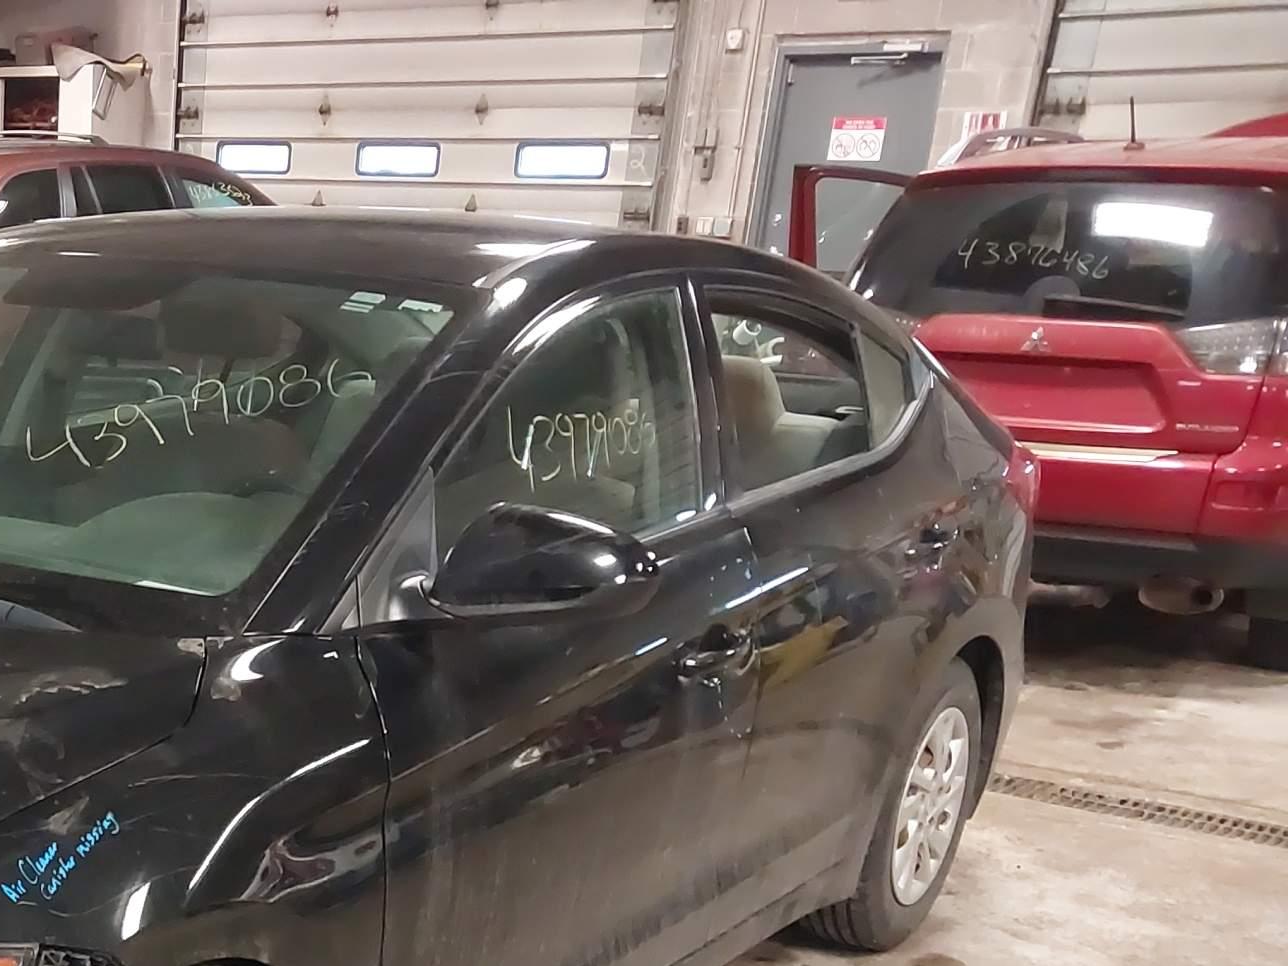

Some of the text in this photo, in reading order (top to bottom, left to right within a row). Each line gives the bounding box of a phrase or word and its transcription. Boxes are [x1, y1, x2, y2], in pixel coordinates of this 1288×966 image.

[25, 357, 375, 468] 43979086
[506, 405, 656, 494] 43979086
[0, 879, 27, 904] Air
